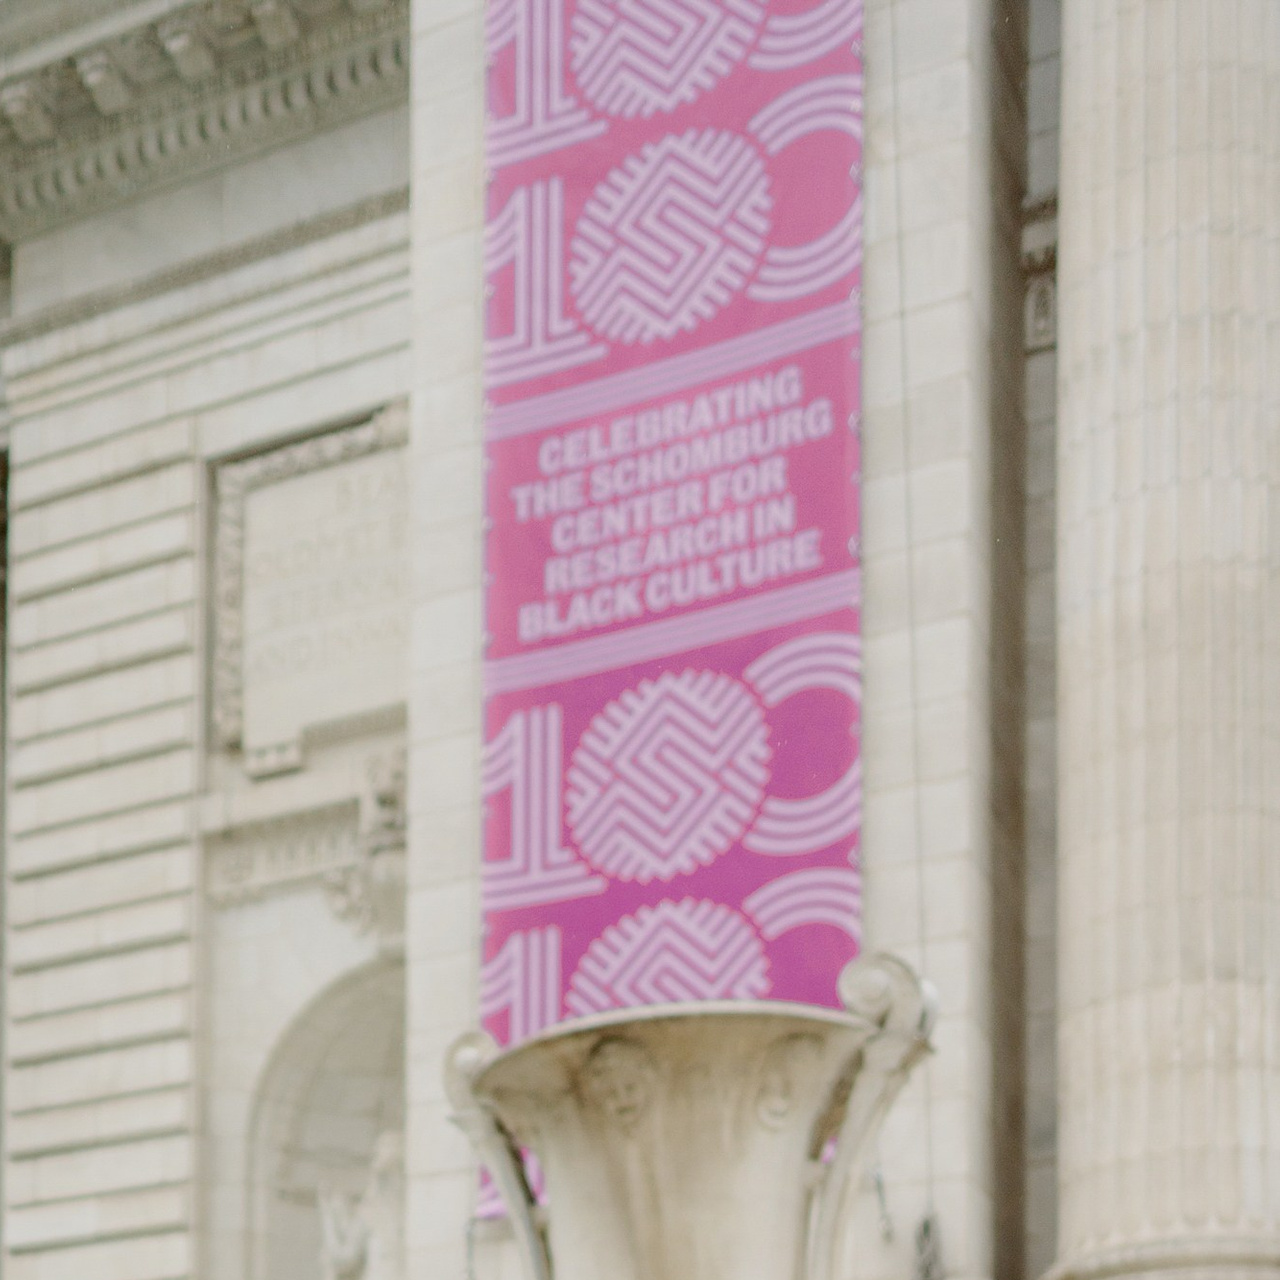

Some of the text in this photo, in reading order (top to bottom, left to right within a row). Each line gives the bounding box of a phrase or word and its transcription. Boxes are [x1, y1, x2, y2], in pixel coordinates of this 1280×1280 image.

[510, 398, 833, 521] THE SCHOMBURG
[539, 365, 802, 475] CELEBRATING
[544, 495, 794, 594] RESEARCH IN
[552, 456, 787, 552] CENTER FOR
[519, 530, 821, 641] BLACK CULTURE
